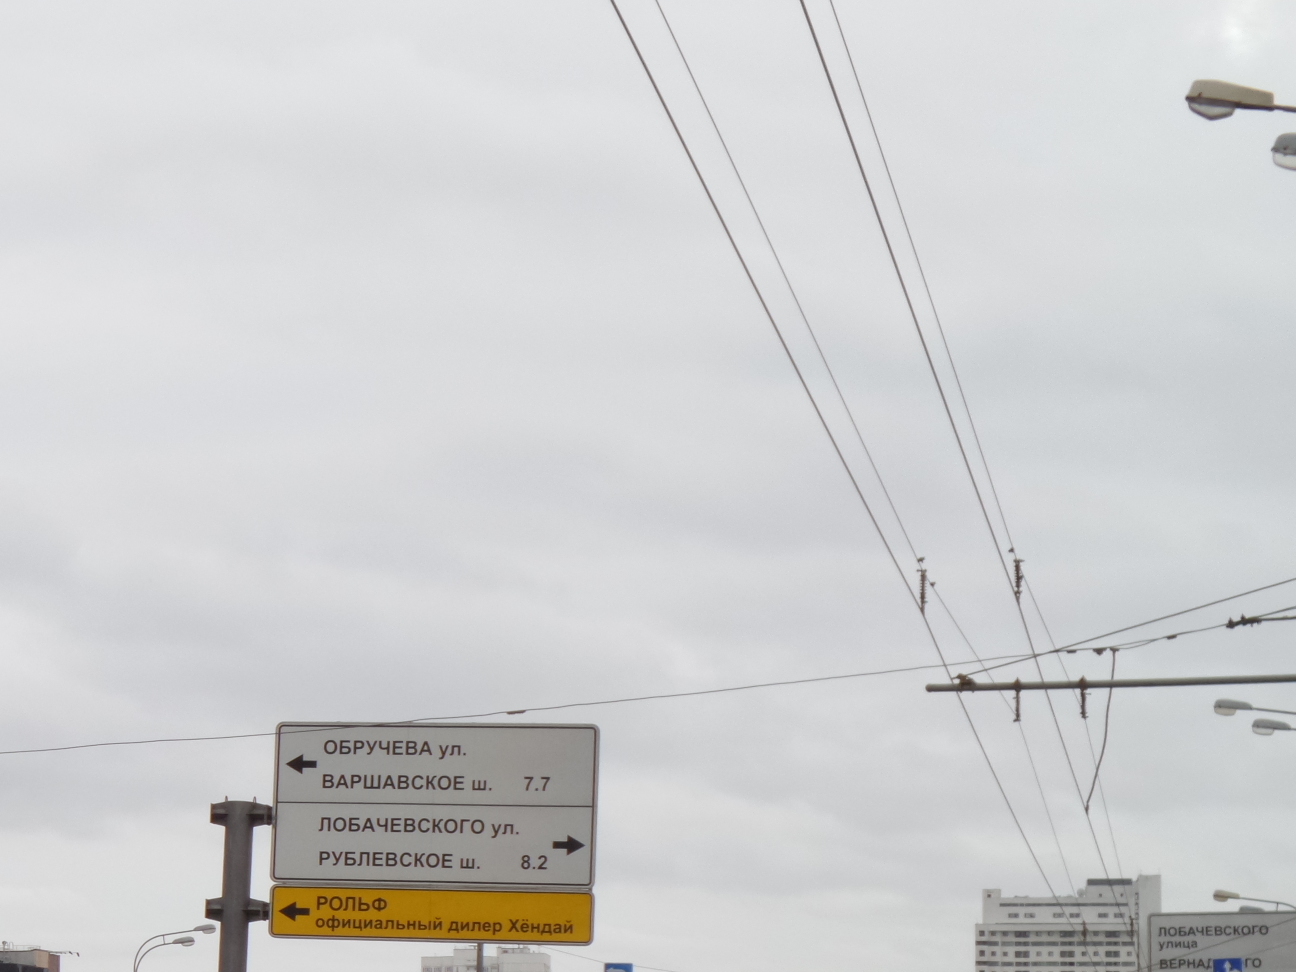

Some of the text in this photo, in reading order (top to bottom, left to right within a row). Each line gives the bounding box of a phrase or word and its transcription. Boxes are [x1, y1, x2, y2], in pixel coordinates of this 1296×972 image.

[323, 740, 467, 760] ОБРУЧЕВА ул.
[322, 774, 551, 792] ВАРШАВСКОЕ ш. 7.7
[318, 817, 520, 838] ЛОБАЧЕВСКОГО ул.
[318, 851, 548, 870] РУБЛЕВСКОЕ ш. 8.2
[315, 896, 388, 912] РОЛЬФ
[315, 916, 574, 935] официальный дилер Хёндай
[1158, 925, 1269, 937] ЛОБАЧЕВСКОГО
[1158, 939, 1198, 951] улица
[1159, 958, 1262, 970] ВЕРНАДГО
